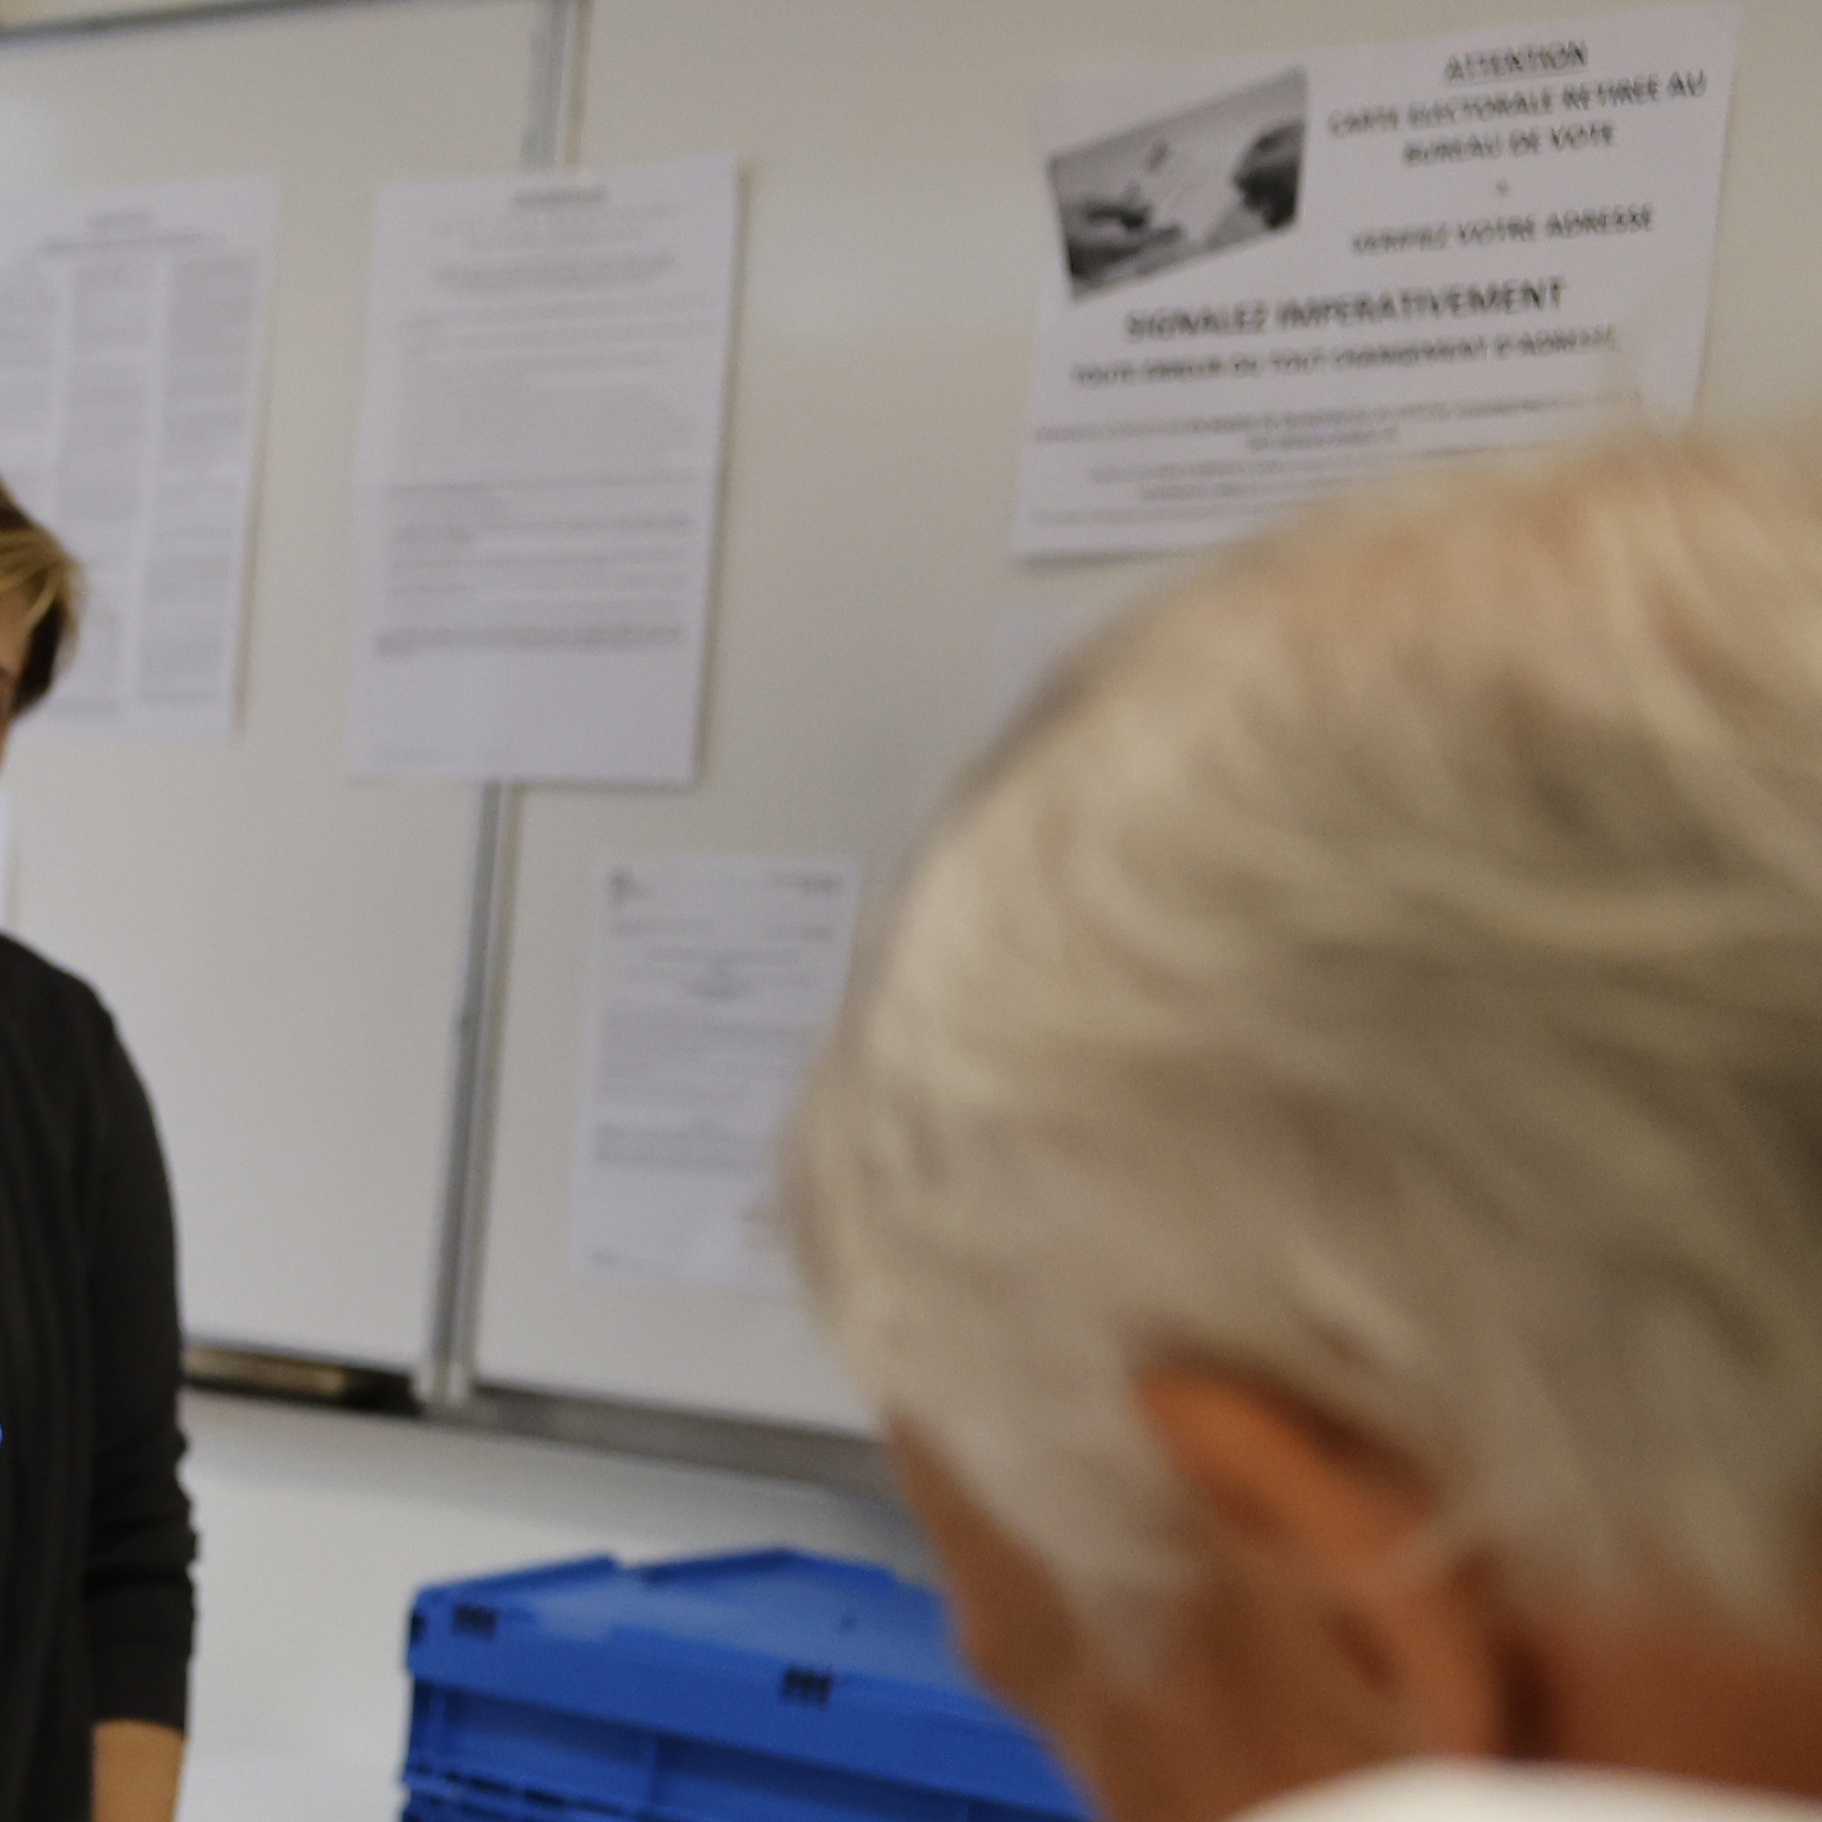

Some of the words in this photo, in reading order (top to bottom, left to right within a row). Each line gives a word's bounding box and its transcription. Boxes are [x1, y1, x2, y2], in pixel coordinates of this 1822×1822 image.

[1444, 40, 1587, 80] ATTENTION
[1667, 69, 1706, 97] AU
[1405, 134, 1503, 167] BUREAU
[1509, 126, 1540, 157] DE
[1551, 120, 1613, 152] VOTE
[1457, 214, 1536, 246] VOTRE
[1545, 202, 1654, 238] ADRESSE
